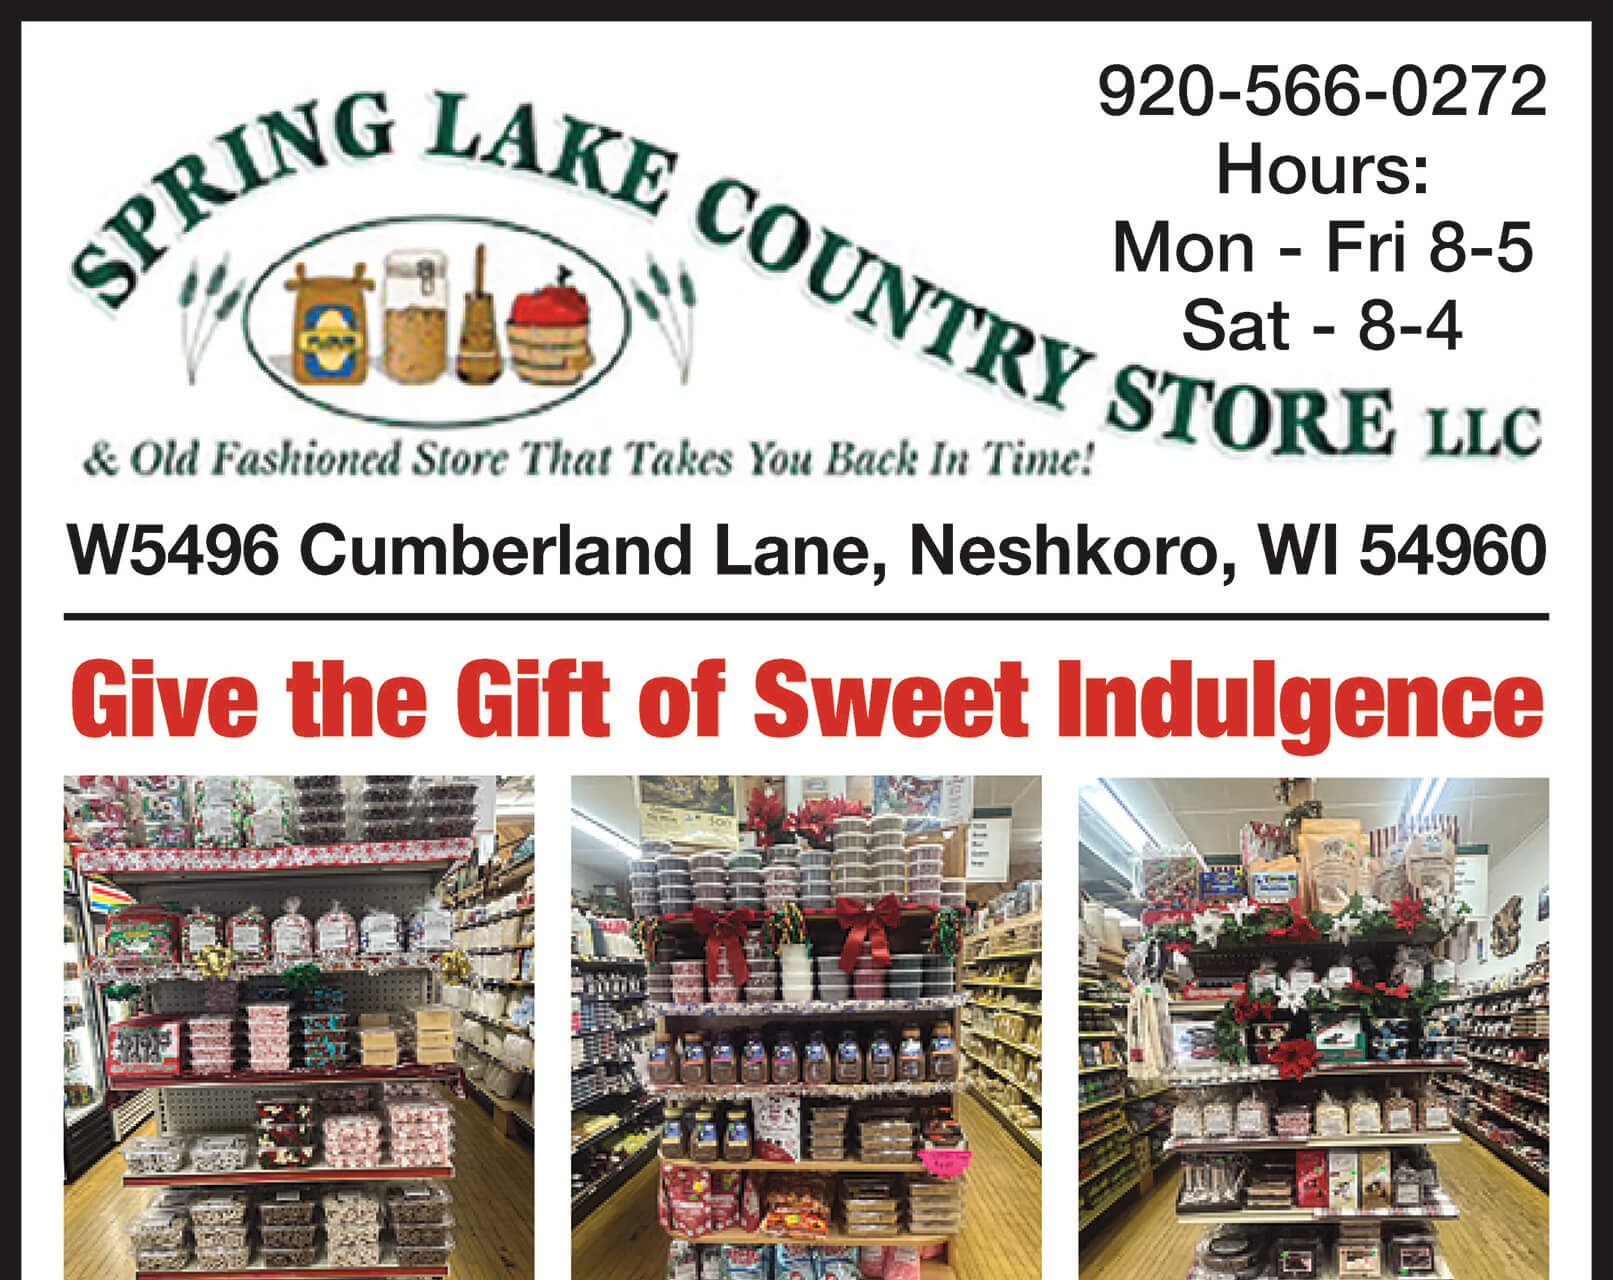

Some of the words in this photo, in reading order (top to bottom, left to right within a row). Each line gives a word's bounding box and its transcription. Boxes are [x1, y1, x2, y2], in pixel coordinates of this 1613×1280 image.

[1100, 64, 1545, 116] 920-566-0272
[1220, 142, 1426, 194] Hours:
[1116, 221, 1252, 272] Mon
[1280, 248, 1301, 256] -
[1329, 221, 1403, 272] Fri
[1431, 221, 1532, 272] 8-5
[70, 91, 395, 310] SPRING
[426, 89, 678, 216] LAKE
[694, 177, 1098, 412] COUNTRY
[1105, 363, 1396, 457] STORE
[1427, 407, 1543, 458] LLC
[1183, 298, 1289, 351] Sat
[1314, 326, 1334, 334] -
[1360, 299, 1462, 350] 8-4
[84, 442, 118, 476] &
[131, 439, 200, 476] Old
[212, 439, 401, 476] Fashioned
[412, 440, 509, 475] Store
[522, 439, 611, 475] That
[626, 439, 732, 476] Takes
[751, 440, 811, 475] You
[826, 439, 918, 476] Back
[931, 440, 969, 475] In
[984, 439, 1095, 476] Time!
[67, 524, 278, 575] W5496
[301, 523, 690, 575] Cumberland
[717, 524, 885, 586] Lane,
[912, 524, 1235, 586] Neshkoro,
[1258, 524, 1336, 574] WI
[1360, 524, 1546, 575] 54960
[72, 659, 257, 738] Give
[286, 660, 426, 738] the
[458, 659, 610, 738] Gift
[639, 659, 725, 738] of
[755, 659, 1028, 738] Sweet
[1059, 660, 1543, 756] Indulgence
